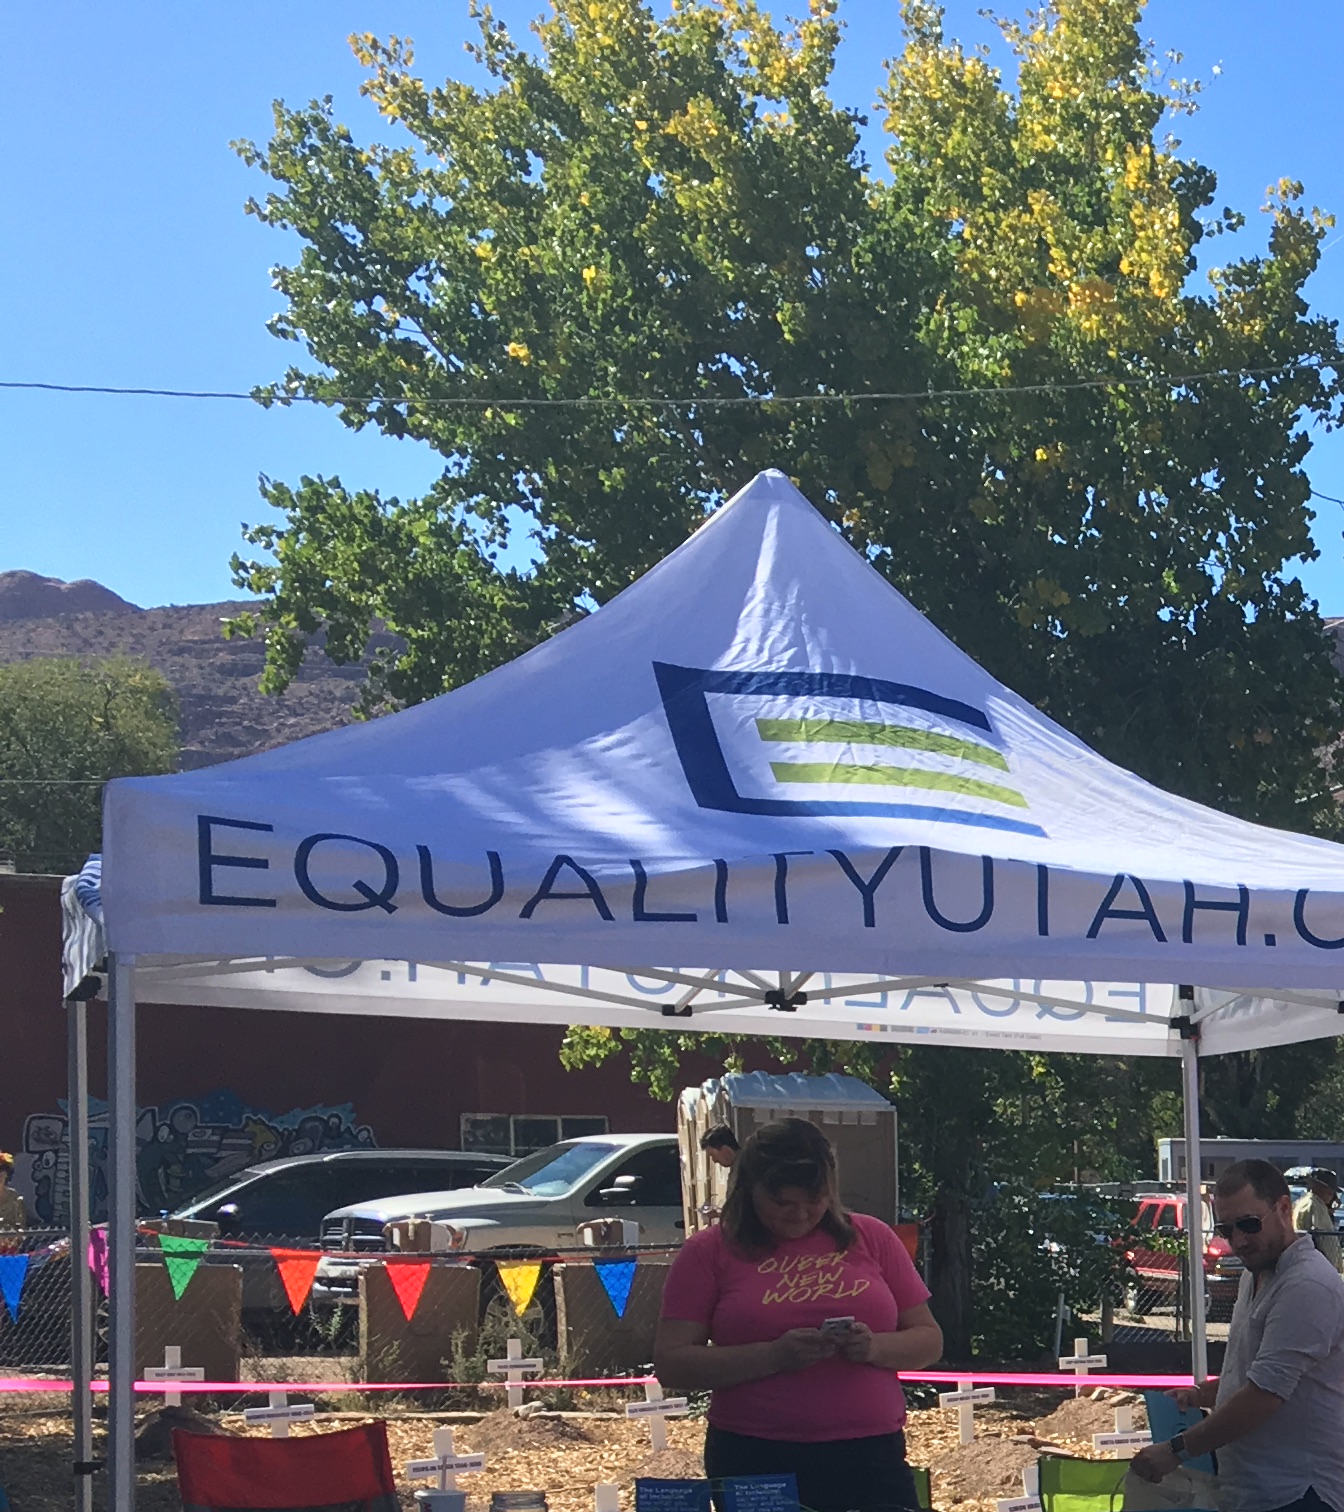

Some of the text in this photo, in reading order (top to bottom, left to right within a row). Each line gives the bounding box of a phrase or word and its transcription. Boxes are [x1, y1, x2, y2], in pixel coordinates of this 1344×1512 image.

[758, 1250, 852, 1273] QUEER
[776, 1267, 844, 1288] NEW
[762, 1280, 870, 1304] WORLD
